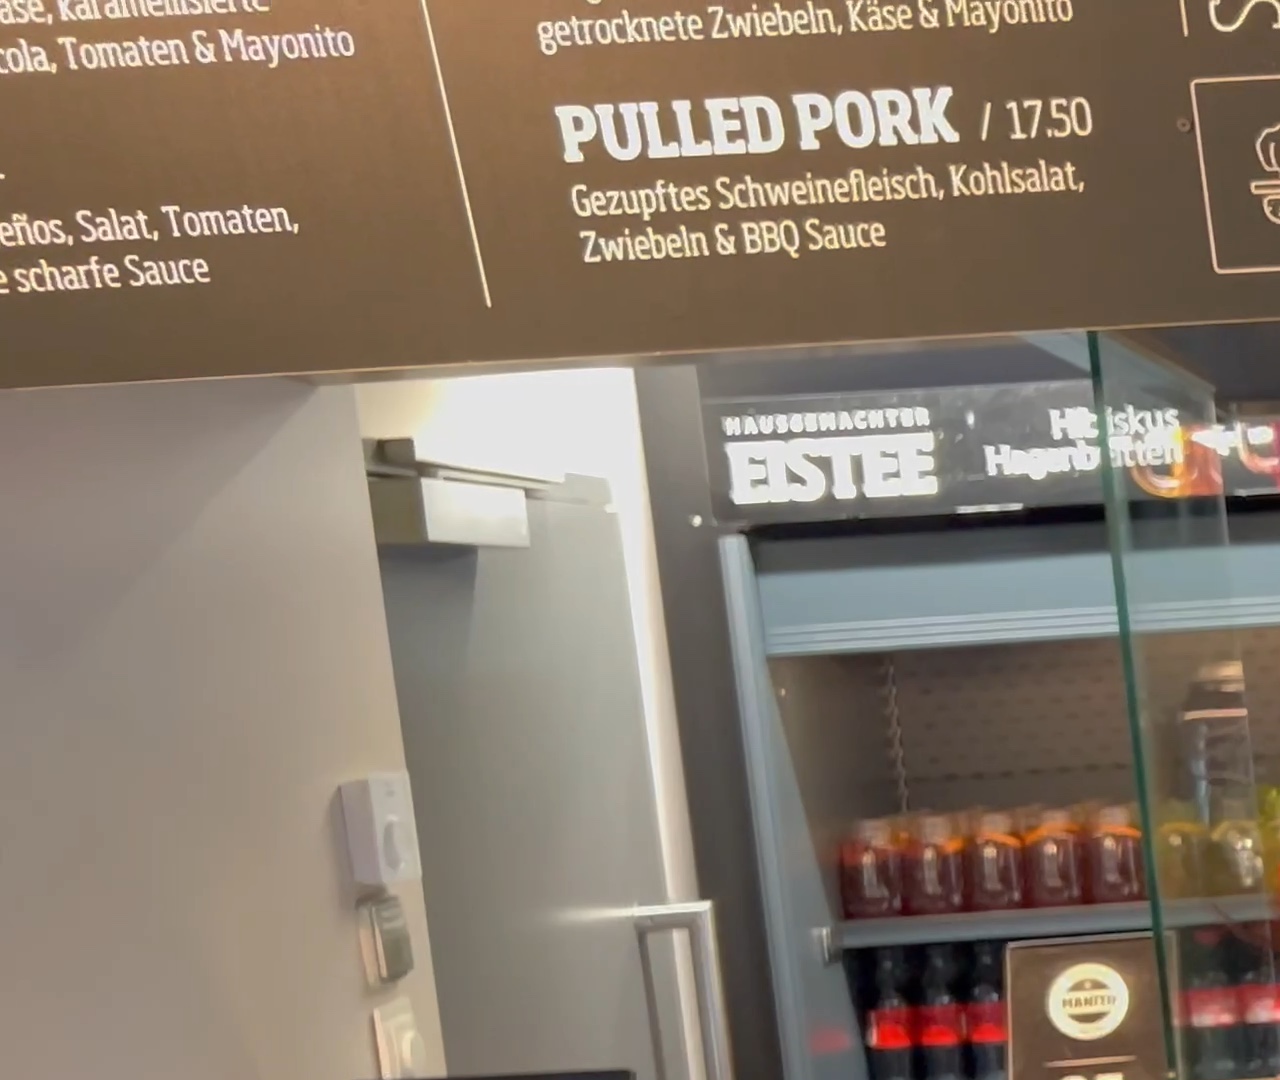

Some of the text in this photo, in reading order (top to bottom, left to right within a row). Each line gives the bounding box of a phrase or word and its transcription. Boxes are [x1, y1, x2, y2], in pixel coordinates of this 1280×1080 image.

[57, 36, 190, 71] Tomaten
[192, 30, 218, 63] &
[217, 24, 355, 69] Mayonito
[537, 0, 1074, 56] getrocknete Zwiebeln, Käse & Mayonito
[555, 86, 1094, 163] PULLED PORK / 17.50
[571, 157, 1085, 220] Gezupftes Schweinefleisch, Kohlsalat,
[75, 207, 160, 243] Salat,
[161, 203, 299, 238] Tomaten,
[580, 217, 887, 263] Zwiebeln & BBQ Sauce
[13, 255, 122, 293] scharfe
[123, 254, 211, 286] Sauce
[722, 406, 932, 436] HAUSGEMACHTER
[726, 432, 938, 505] EISTEE
